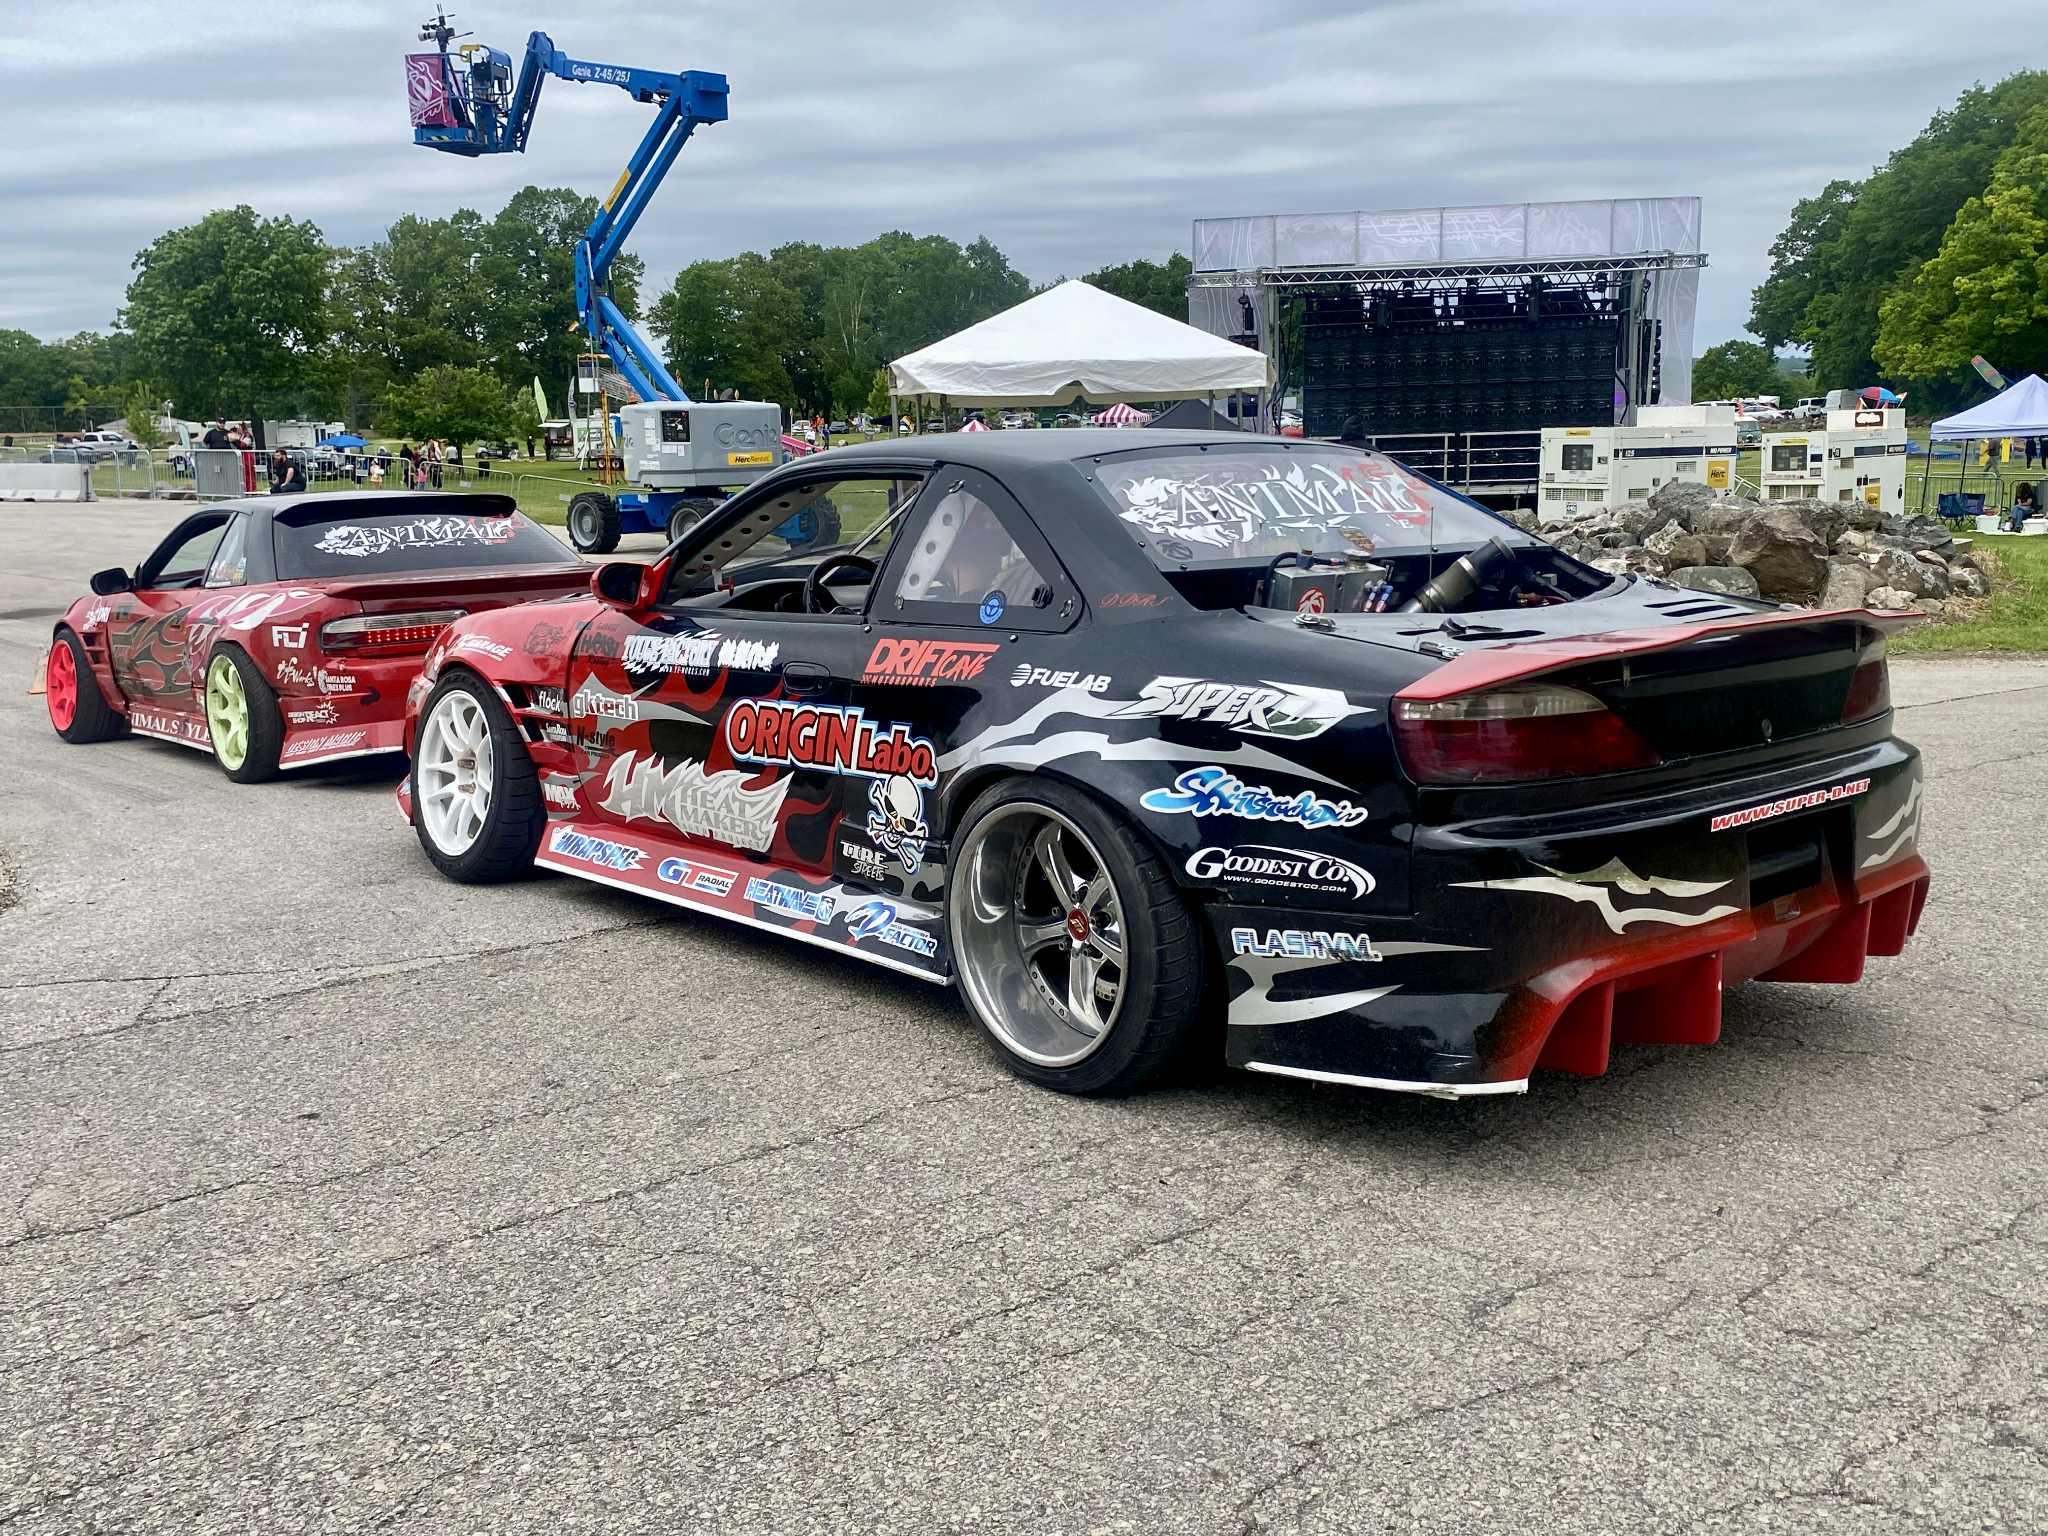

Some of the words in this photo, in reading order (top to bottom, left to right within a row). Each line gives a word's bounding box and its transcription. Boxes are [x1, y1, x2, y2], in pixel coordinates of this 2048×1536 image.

[594, 67, 631, 83] Z-45/25J
[1174, 477, 1424, 528] ANIMAL
[865, 638, 1000, 678] DRIFT
[871, 675, 938, 688] MOTORSPORTS
[1030, 667, 1112, 692] FUELAB
[539, 690, 560, 712] flock
[573, 689, 639, 720] gktech
[1128, 676, 1288, 731] SUPER
[730, 702, 858, 772] ORIGIN
[1711, 778, 1871, 832] WWW.SUPER-D.NET
[552, 830, 643, 872] WRAPSPEC
[841, 840, 889, 869] TIRE
[697, 874, 731, 889] RADIAL
[882, 928, 937, 954] FACTOR
